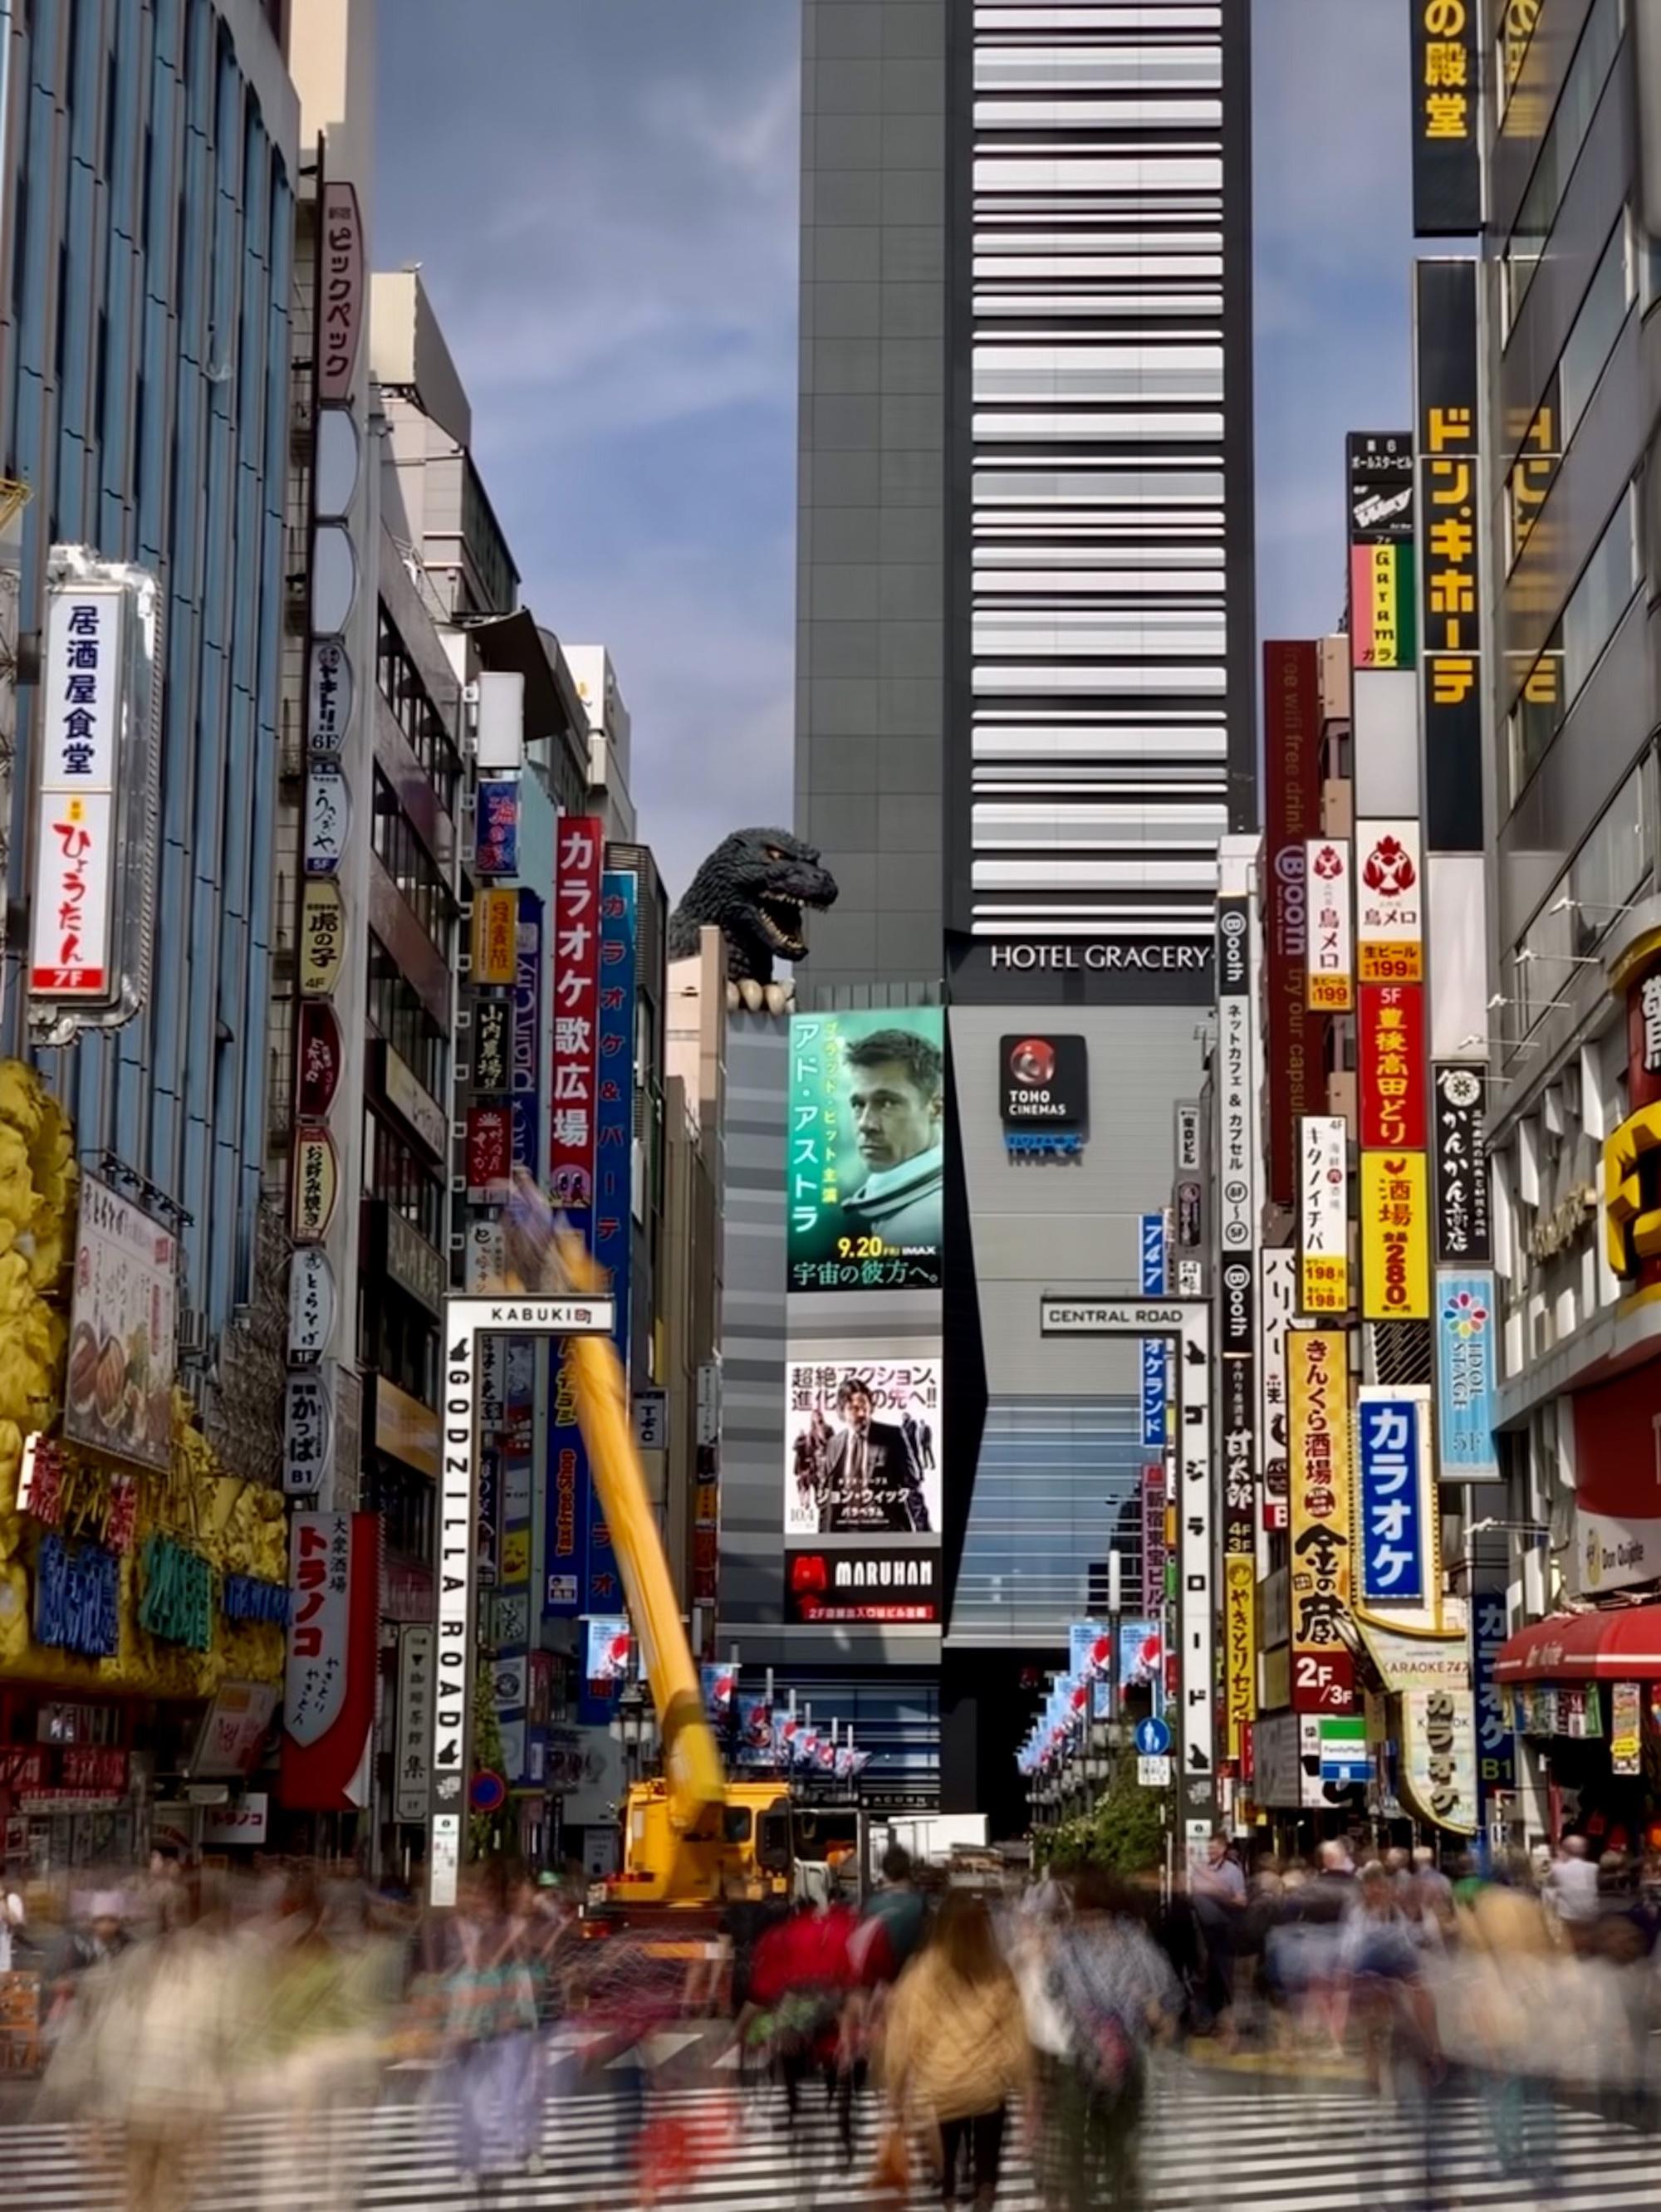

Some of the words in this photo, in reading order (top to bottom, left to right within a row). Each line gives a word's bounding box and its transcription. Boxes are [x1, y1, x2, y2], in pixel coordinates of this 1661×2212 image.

[1424, 0, 1467, 138] の殿堂
[1428, 407, 1474, 702] ドン・キホーテ
[1374, 551, 1395, 641] Garam
[62, 605, 100, 775] 居酒屋食堂
[311, 735, 339, 749] 6F
[52, 823, 91, 966] ひょうたん
[1364, 908, 1417, 927] 鳥メロ
[308, 913, 339, 969] 虎の子
[991, 945, 1080, 969] HOTEL
[1084, 944, 1211, 969] GRACERY
[1221, 911, 1247, 981] Booth
[1319, 908, 1340, 969] 鳥メロ
[1364, 946, 1418, 959] 生ビール
[52, 970, 84, 988] 7F
[553, 831, 592, 1148] カラオケ歌広場
[1316, 987, 1348, 1001] 199
[1380, 988, 1402, 1004] 5F
[478, 1004, 503, 1077] 山内農場
[1009, 1089, 1051, 1103] TOHO
[1286, 1044, 1309, 1115] capsul
[1375, 1007, 1409, 1145] 豊後高田どり
[792, 1023, 820, 1234] アド・アストラ
[1008, 1104, 1066, 1115] CINEMAS
[304, 1144, 324, 1227] お好み焼き
[1379, 1178, 1414, 1228] 酒場
[792, 1260, 938, 1287] 宇宙の彼方へ。
[837, 1236, 883, 1259] 9.20
[902, 1245, 937, 1256] IMAX
[1144, 1225, 1163, 1287] 747
[1305, 1266, 1335, 1280] 198
[1385, 1244, 1407, 1305] 280
[1049, 1309, 1129, 1323] CENTRAL
[1135, 1309, 1183, 1323] ROAD
[1223, 1264, 1251, 1337] Booth
[1306, 1294, 1336, 1307] 198
[295, 1351, 315, 1364] 1F
[791, 1366, 937, 1388] 超絶アクション、
[1453, 1343, 1469, 1411] STAGE
[1468, 1343, 1484, 1398] IDOL
[1304, 1339, 1331, 1485] きんくら酒場
[1225, 1428, 1254, 1510] 甘太郎
[1453, 1431, 1484, 1453] 5F
[291, 1470, 313, 1483] B1
[442, 1372, 471, 1593] GODZILLA
[816, 1488, 910, 1505] ジョン・ウィック
[1369, 1408, 1414, 1587] カラオケ
[840, 1507, 884, 1518] パラベラム
[1228, 1524, 1252, 1537] 4F
[329, 1517, 348, 1594] 大衆酒場
[1184, 1403, 1208, 1706] ゴジラロード
[1228, 1538, 1252, 1553] 3F
[1602, 1548, 1615, 1569] Don
[1617, 1541, 1644, 1569] Quijote
[293, 1526, 328, 1659] トラノコ
[834, 1560, 933, 1587] MARUHAN
[1294, 1523, 1350, 1644] 金の蔵
[439, 1619, 464, 1729] ROAD
[1296, 1657, 1333, 1687] 2F
[1383, 1661, 1444, 1674] KARAOKE
[1478, 1603, 1506, 1750] カラオケ
[1426, 1691, 1459, 1817] カラオケ
[1481, 1758, 1512, 1780] B1
[213, 1810, 263, 1826] トラノコ
